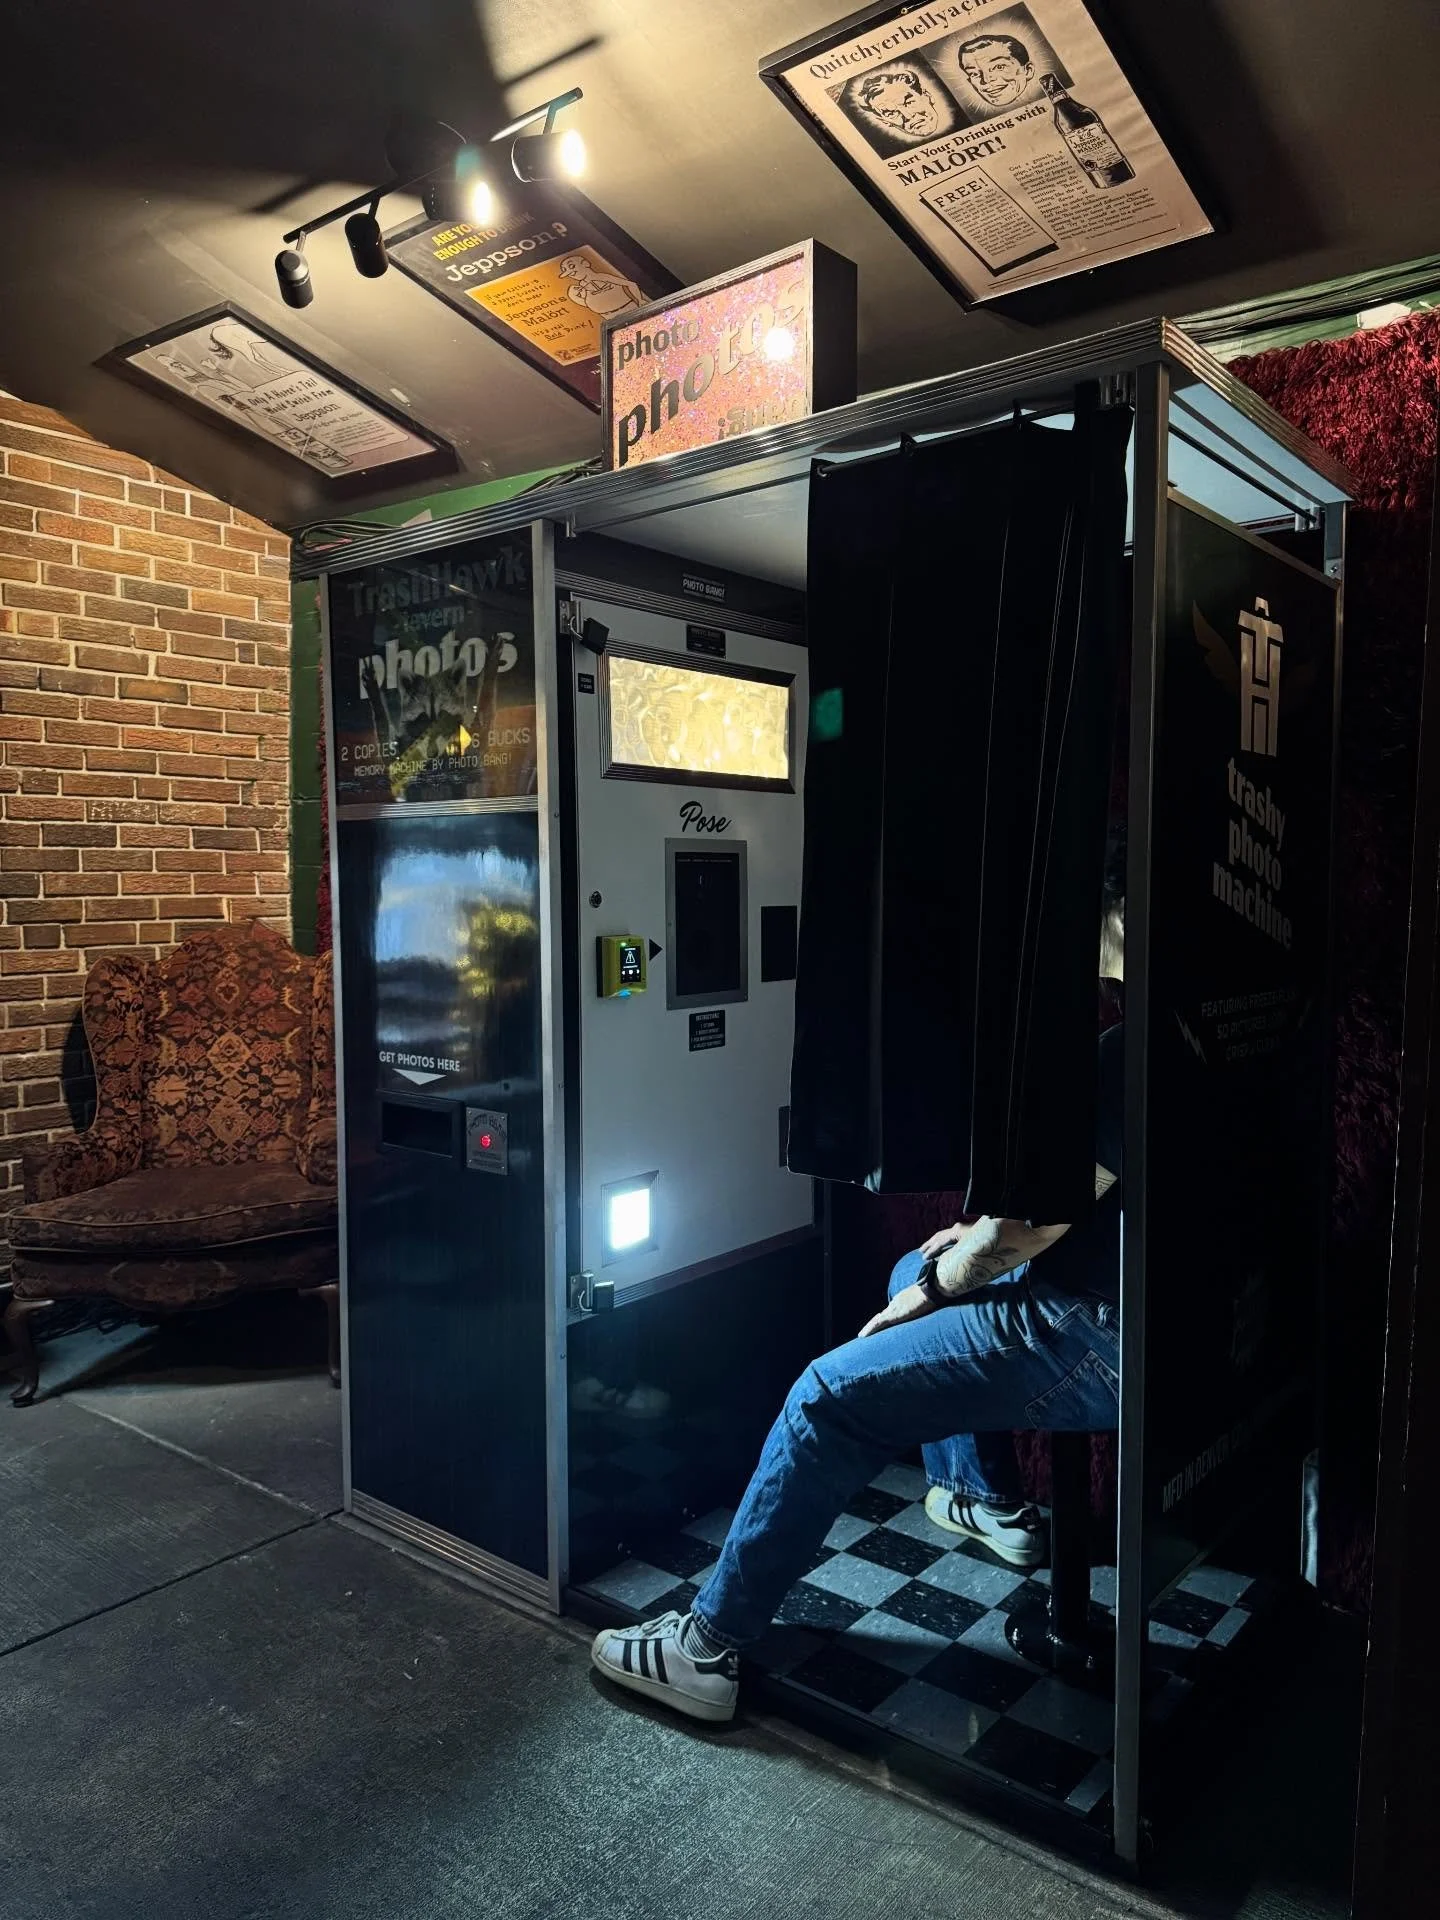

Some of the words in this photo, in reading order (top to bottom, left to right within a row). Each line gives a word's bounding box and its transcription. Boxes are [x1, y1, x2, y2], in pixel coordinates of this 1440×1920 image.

[887, 154, 919, 171] Start
[920, 142, 951, 158] Your
[953, 117, 1015, 147] Drinking
[1014, 104, 1047, 123] with
[896, 136, 1007, 187] MALÖRT!
[933, 177, 989, 208] FREE!
[431, 227, 458, 247] ARE
[433, 235, 484, 261] ENOUGH
[478, 228, 499, 241] TO
[505, 295, 568, 322] Jeppson's
[521, 307, 570, 327] Malört
[618, 318, 700, 370] photo
[618, 278, 805, 466] photos
[291, 403, 341, 422] Jeppson
[682, 578, 704, 592] PHOTO
[359, 630, 518, 700] photos
[341, 746, 348, 762] 2
[354, 742, 397, 760] COPIES
[487, 727, 531, 747] BUCKS
[354, 765, 386, 777] MEMORY
[389, 758, 428, 774] MACHINE
[432, 759, 444, 769] BY
[449, 755, 479, 769] PHOTO
[483, 752, 513, 767] BANG!
[680, 800, 732, 832] Pose
[1228, 756, 1286, 851] trashy
[1229, 818, 1282, 892] photo
[1213, 861, 1292, 951] machine
[379, 1051, 396, 1063] GET
[397, 1053, 435, 1069] PHOTOS
[437, 1058, 461, 1072] HERE
